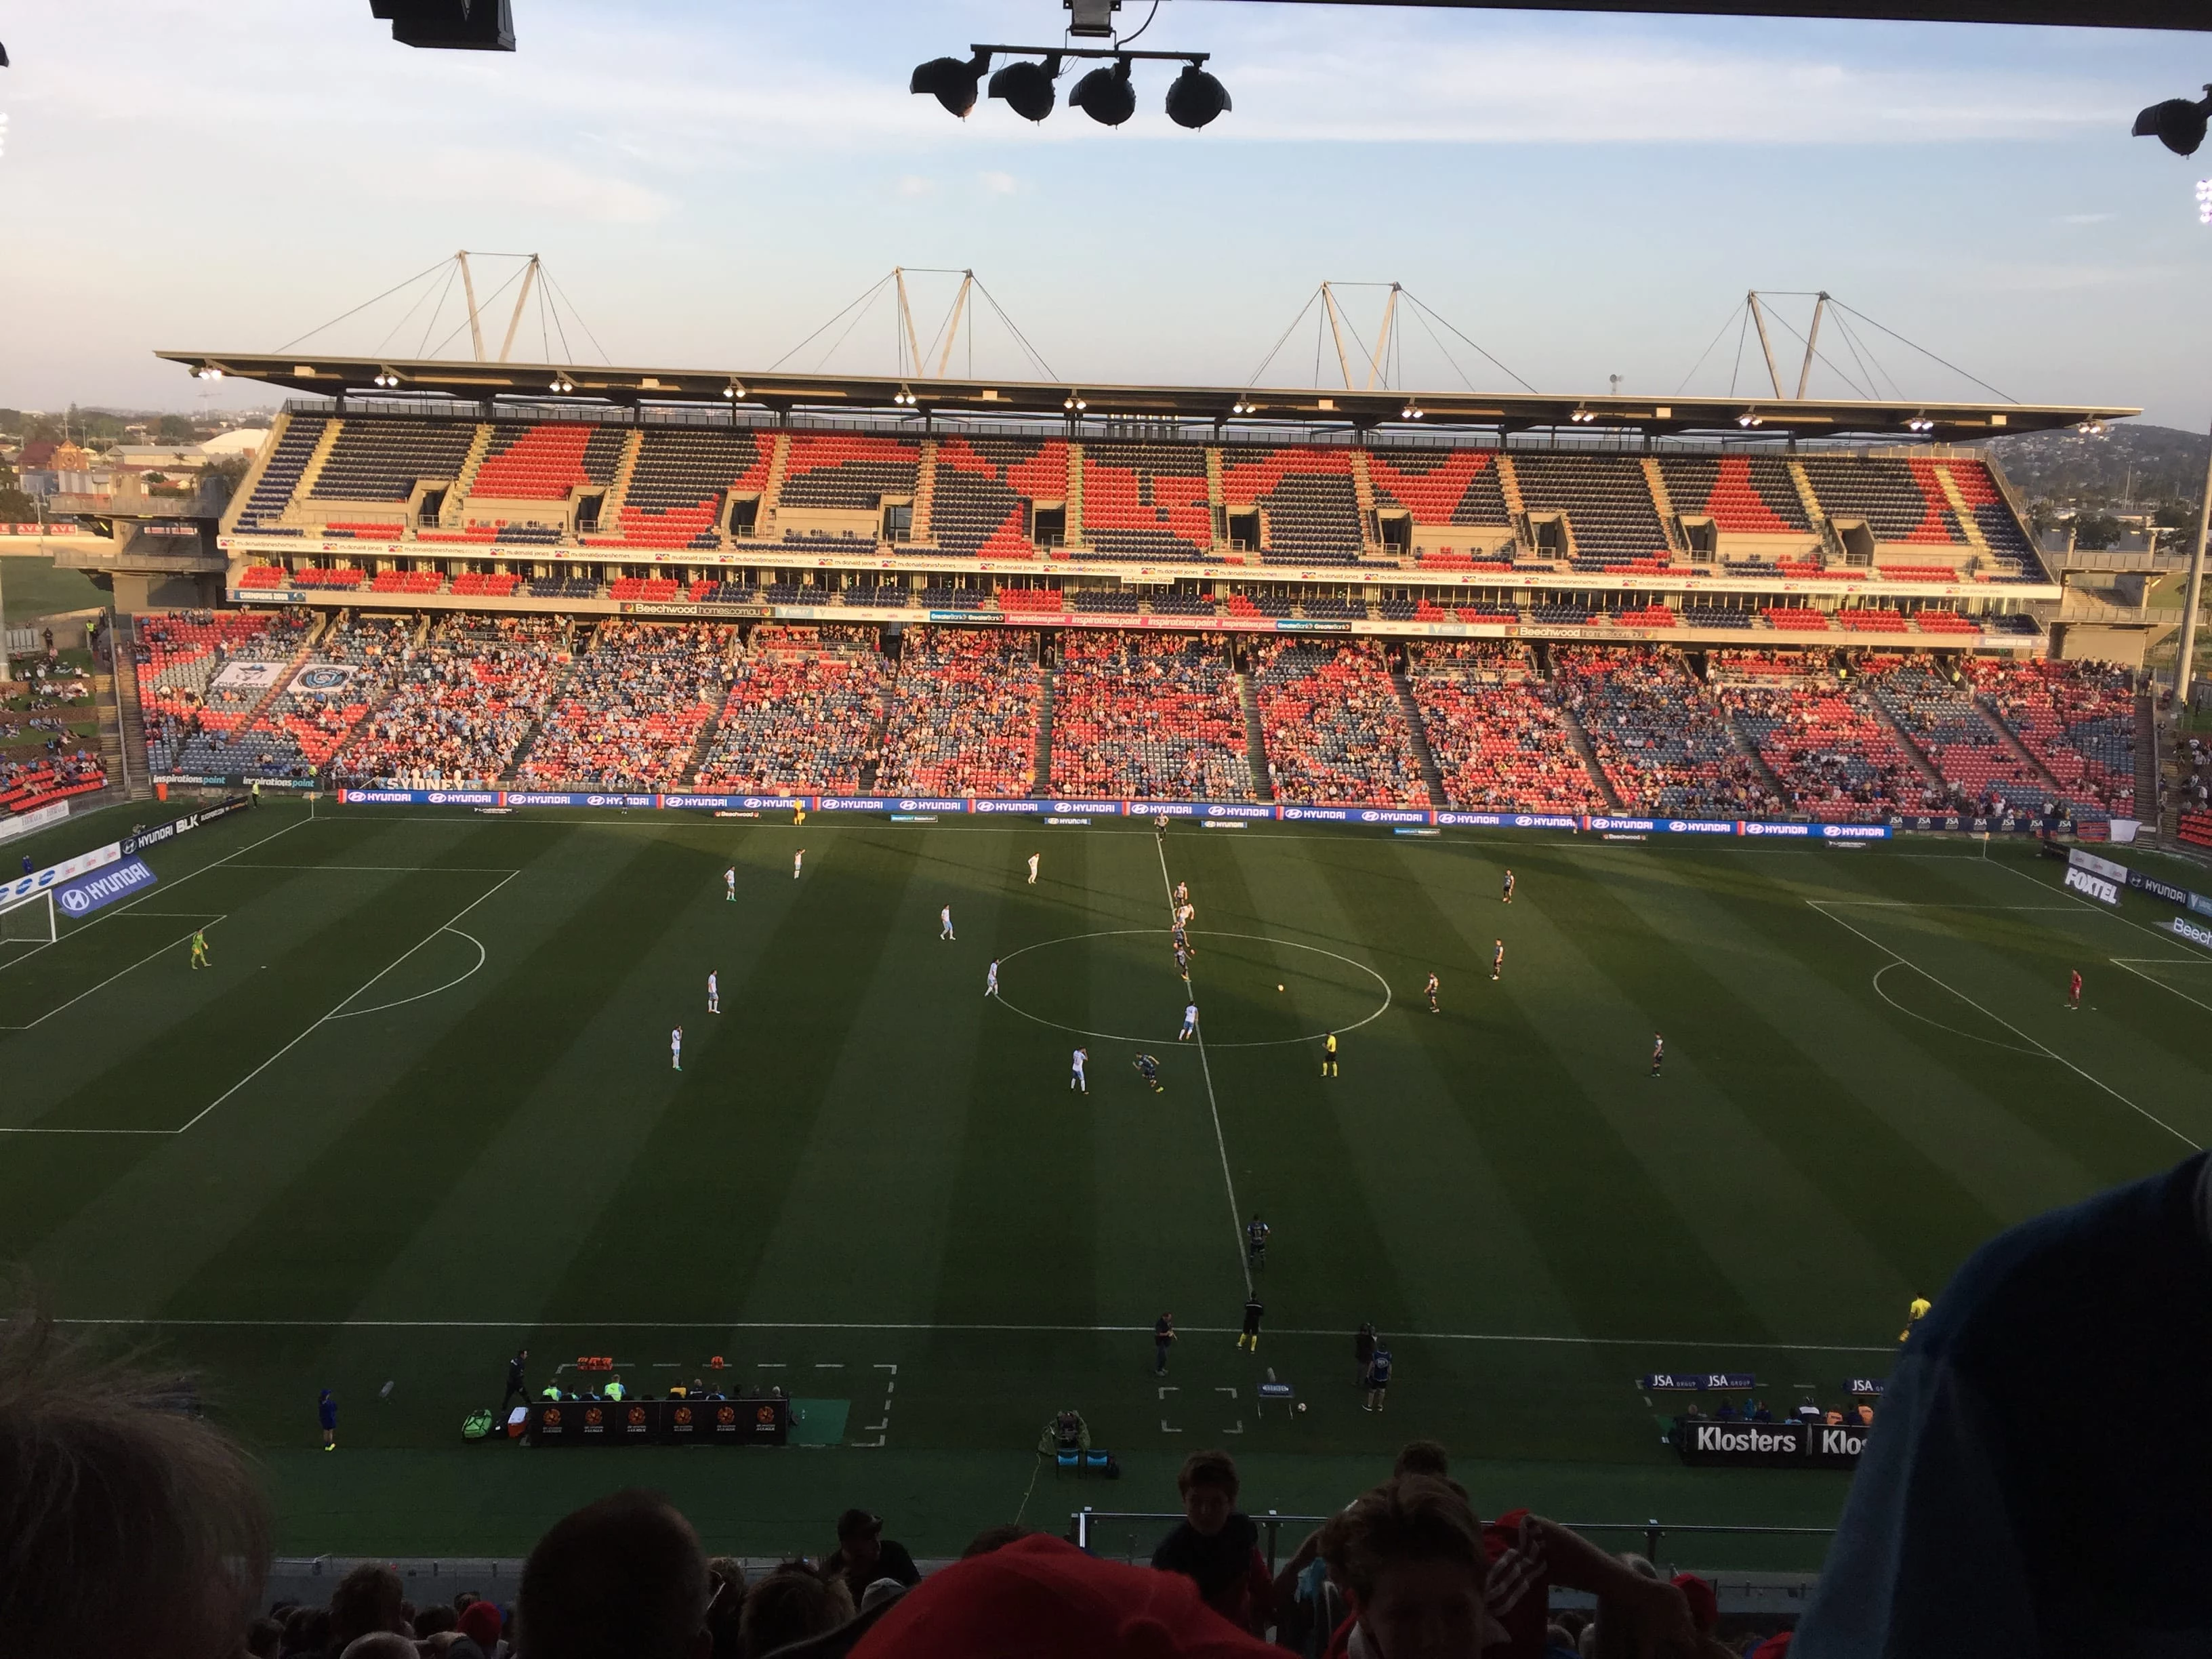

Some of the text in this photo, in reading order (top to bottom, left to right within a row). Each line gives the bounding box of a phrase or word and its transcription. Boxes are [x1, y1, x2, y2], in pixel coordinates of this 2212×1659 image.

[636, 603, 697, 614] Beechwood
[1520, 627, 1580, 637] Beechwood
[387, 777, 466, 790] SYDNEY
[367, 793, 411, 802] HYUNDAI
[447, 794, 491, 803] HYUNDAI
[527, 796, 571, 804] HYUNDAI
[607, 797, 649, 806] HYNDAI
[684, 798, 727, 807] HYUNDAI
[762, 800, 805, 808] HYUNDI
[840, 801, 883, 810] HYUNDAI
[918, 802, 960, 811] HYUNDAI
[996, 804, 1038, 813] HYUNDAI
[1073, 804, 1115, 813] HYUNDAI
[1150, 806, 1192, 815] HYUNDAI
[1227, 808, 1269, 817] HYUNDAI
[1303, 810, 1345, 819] HYUNDAI
[1380, 813, 1422, 821] HYUNDAI
[176, 814, 199, 834] BLK
[1457, 815, 1499, 824] HYUNDAI
[1611, 820, 1653, 829] HYUNDAI
[1688, 823, 1730, 832] HYUNDAI
[1765, 825, 1807, 834] HYUNDAI
[1842, 827, 1884, 836] HYUNDAI
[138, 825, 173, 848] HYUNDAI
[85, 863, 150, 900] HYUNDAI
[2065, 867, 2118, 905] FOXTEL
[2145, 879, 2186, 904] HYUNDAI
[1652, 1374, 1674, 1387] JSA
[1708, 1374, 1728, 1387] JSA
[1851, 1379, 1874, 1391] JSA
[1698, 1427, 1797, 1452] Klosters
